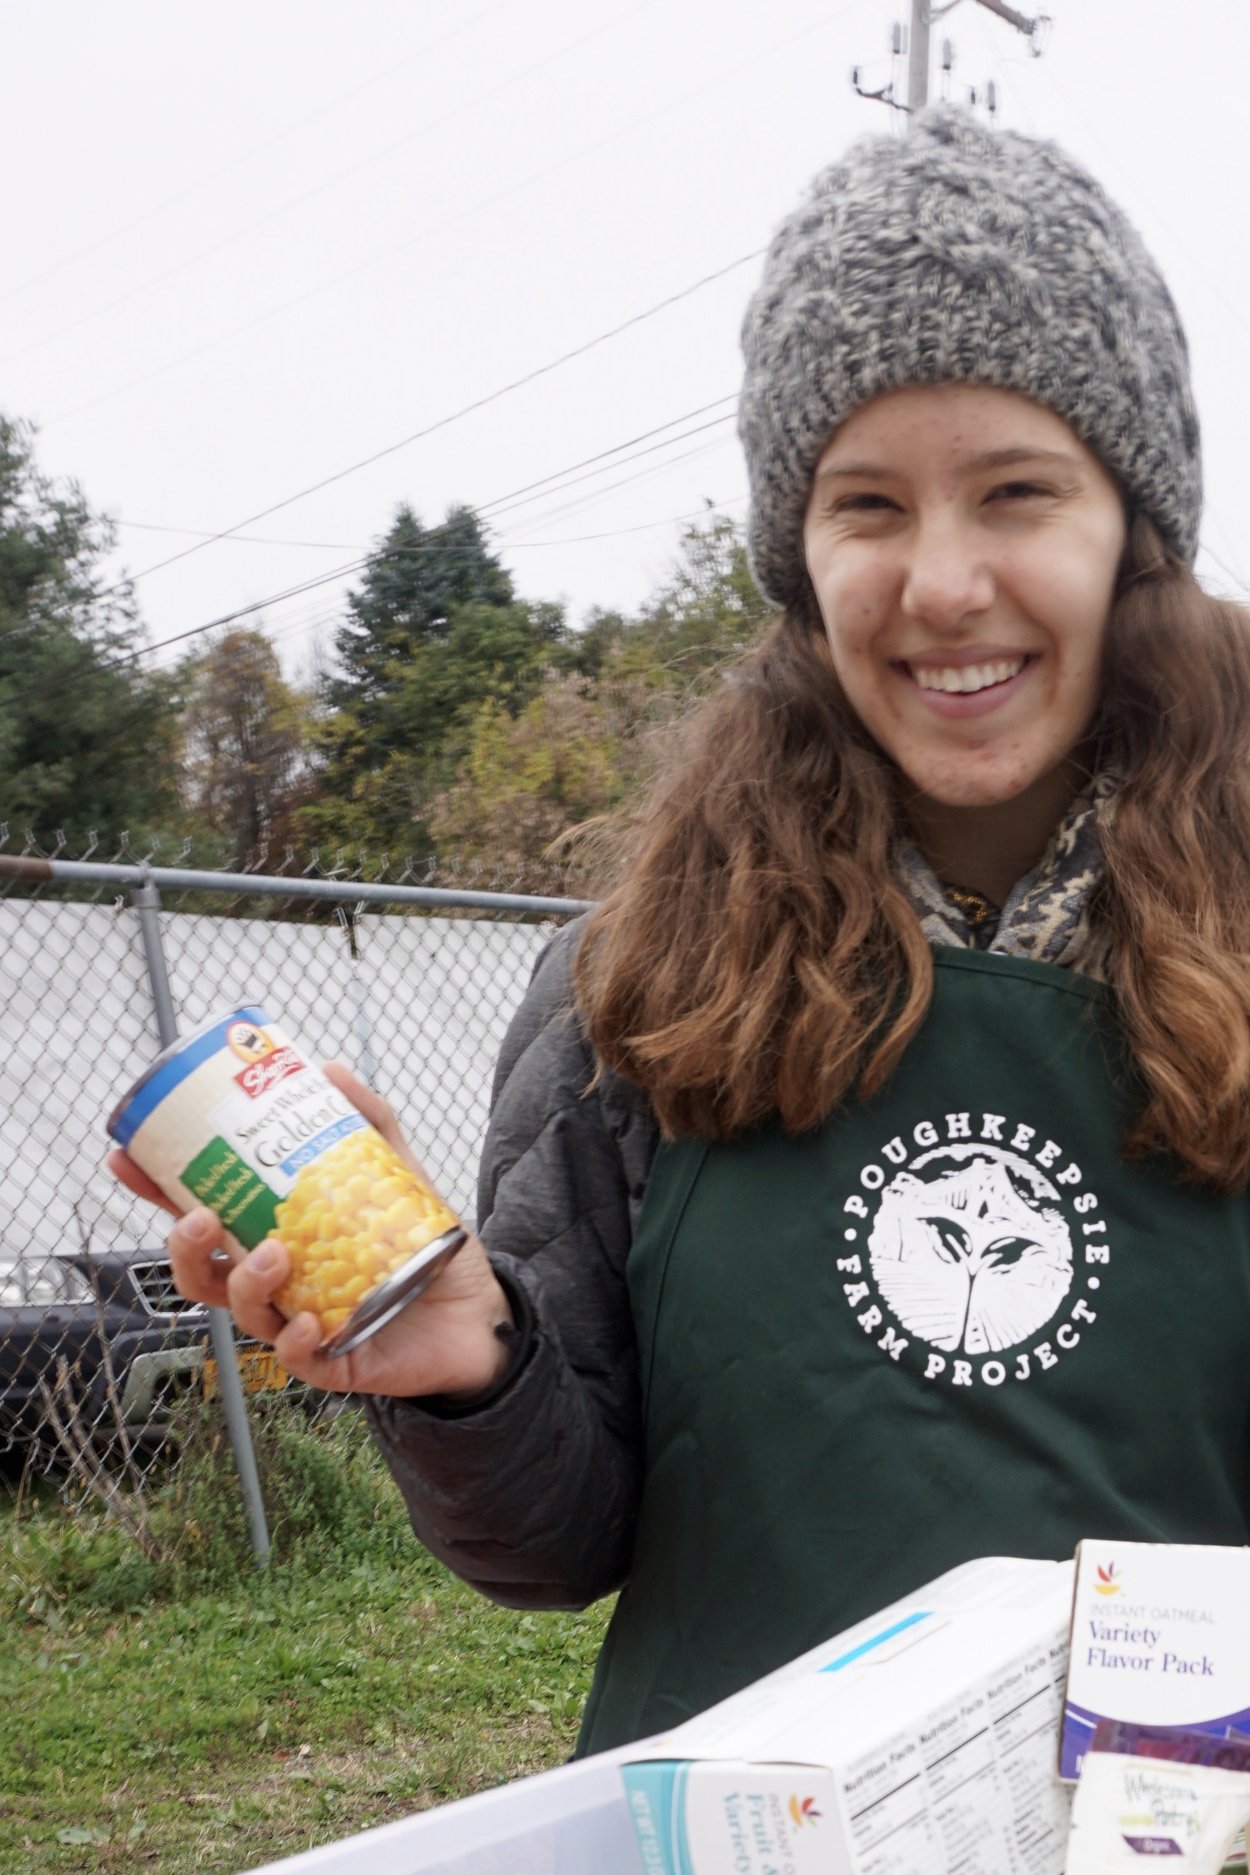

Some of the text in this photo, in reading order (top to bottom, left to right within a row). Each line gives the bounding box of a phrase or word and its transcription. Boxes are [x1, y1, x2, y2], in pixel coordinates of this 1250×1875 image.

[234, 1107, 281, 1144] Sweet
[254, 1107, 331, 1168] Golden
[843, 1112, 1111, 1266] POUGHKEEPSIE
[836, 1254, 909, 1361] FARM
[923, 1298, 1098, 1388] PROJECT
[1086, 1648, 1156, 1674] Flavor
[1161, 1652, 1214, 1678] Pack
[1087, 1620, 1162, 1650] Variety
